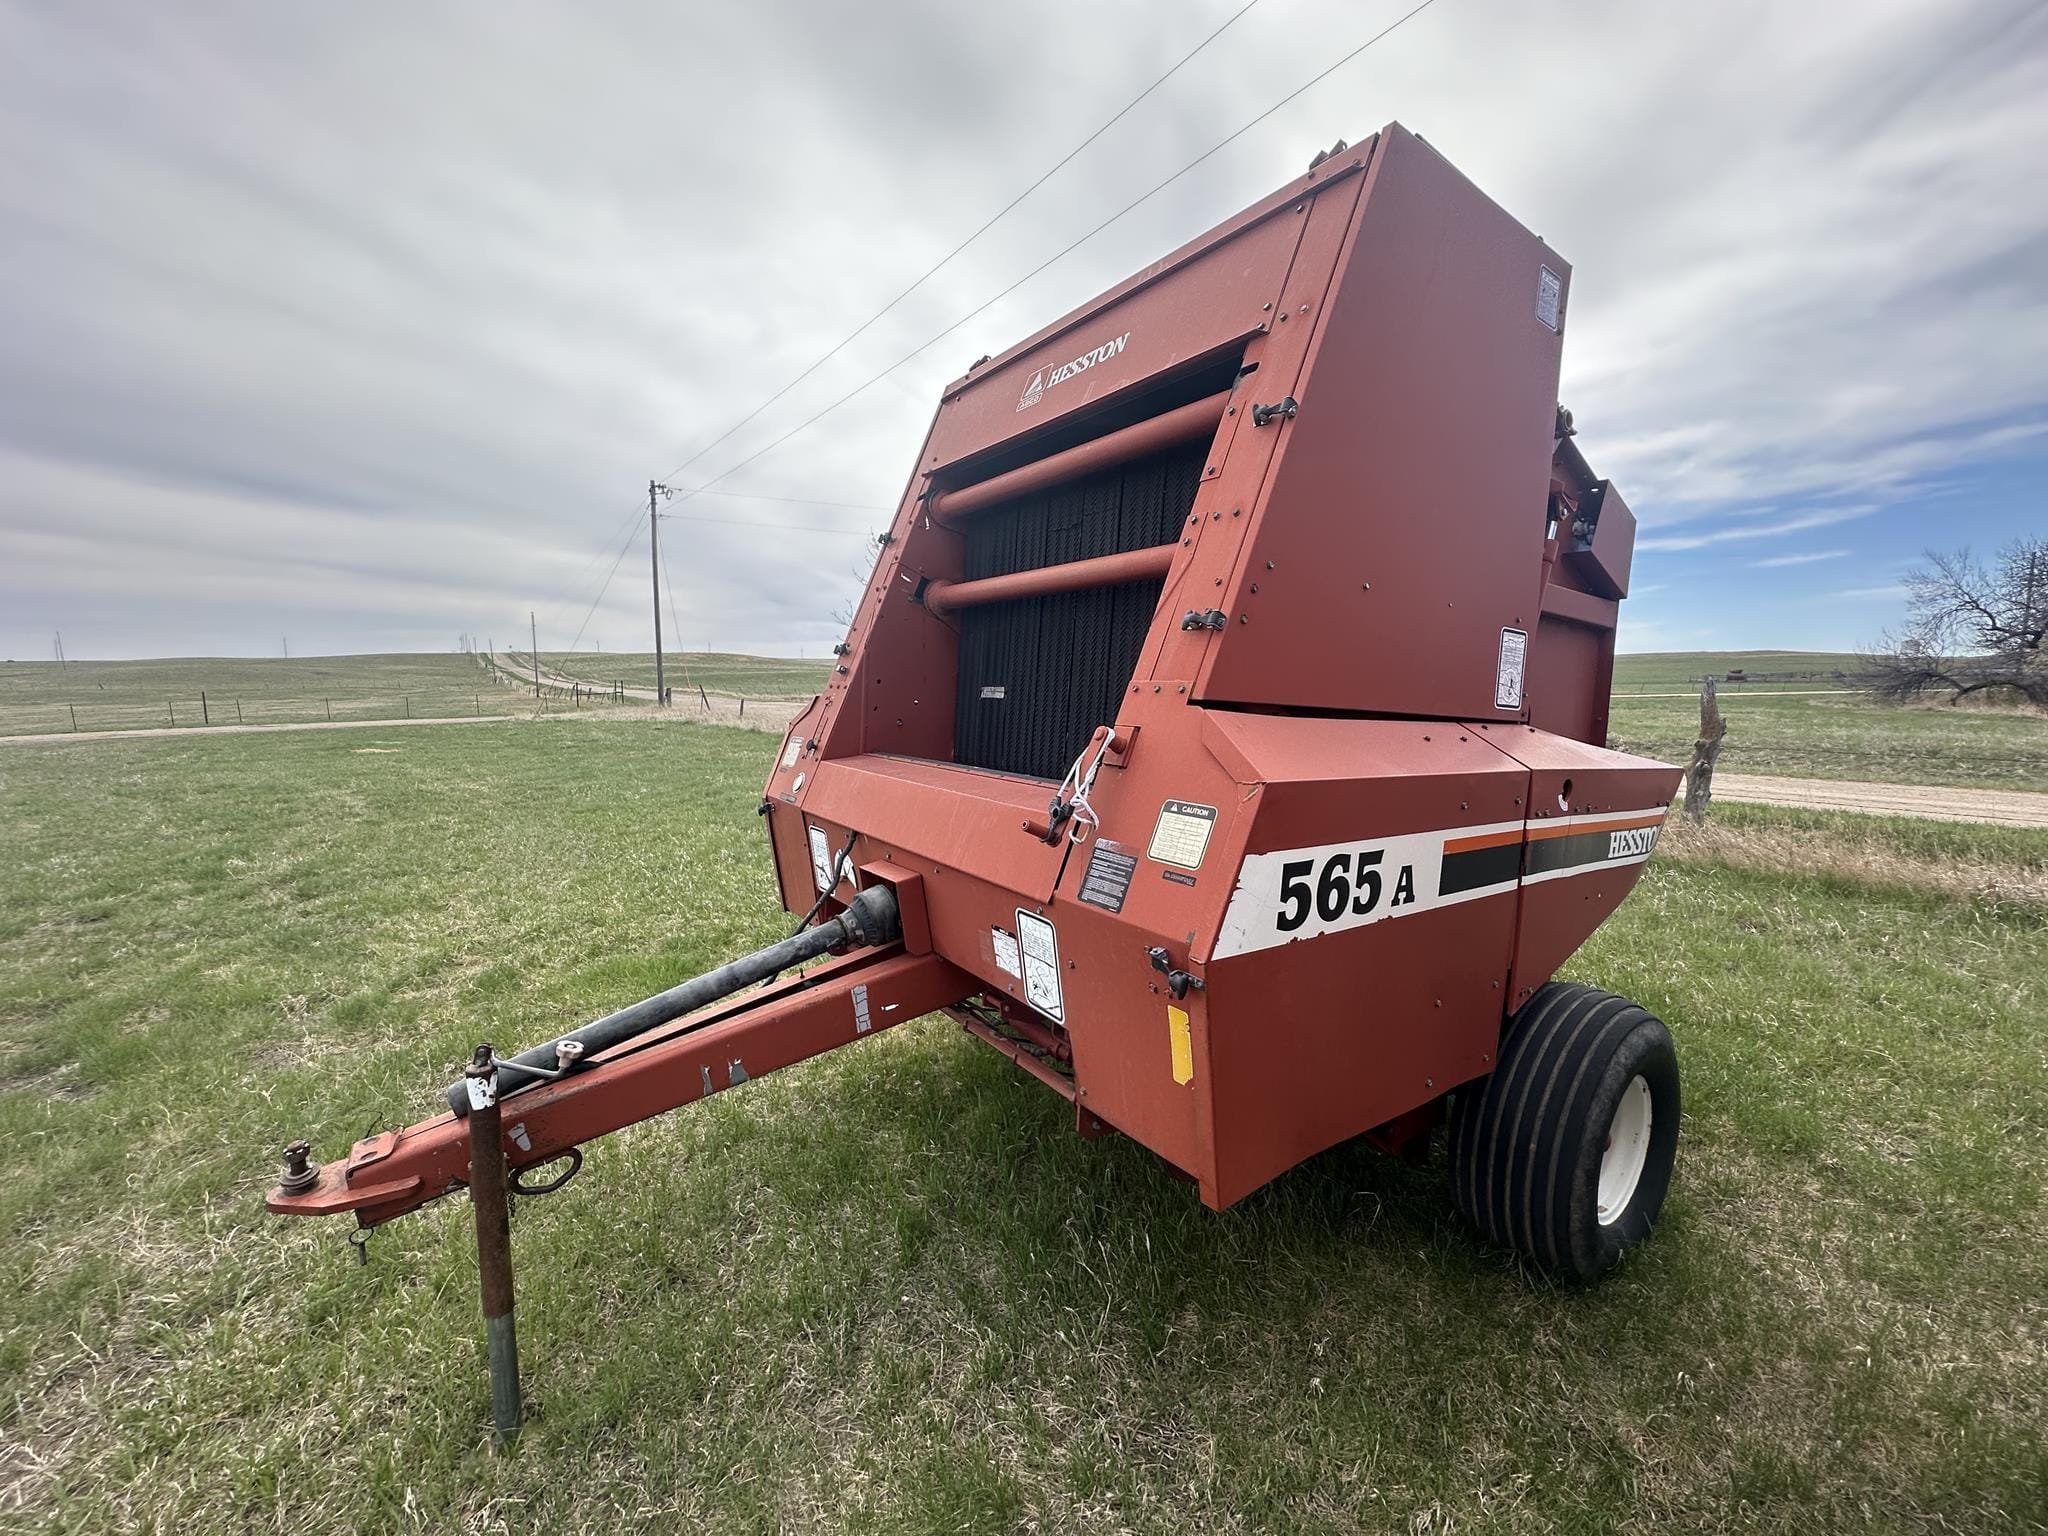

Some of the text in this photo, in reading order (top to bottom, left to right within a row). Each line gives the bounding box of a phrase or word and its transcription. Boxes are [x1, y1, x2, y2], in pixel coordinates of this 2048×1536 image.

[1047, 332, 1130, 388] HESSTON
[1182, 805, 1209, 817] CAUTION
[1608, 825, 1660, 858] HESSTO
[1276, 849, 1416, 931] 565 A
